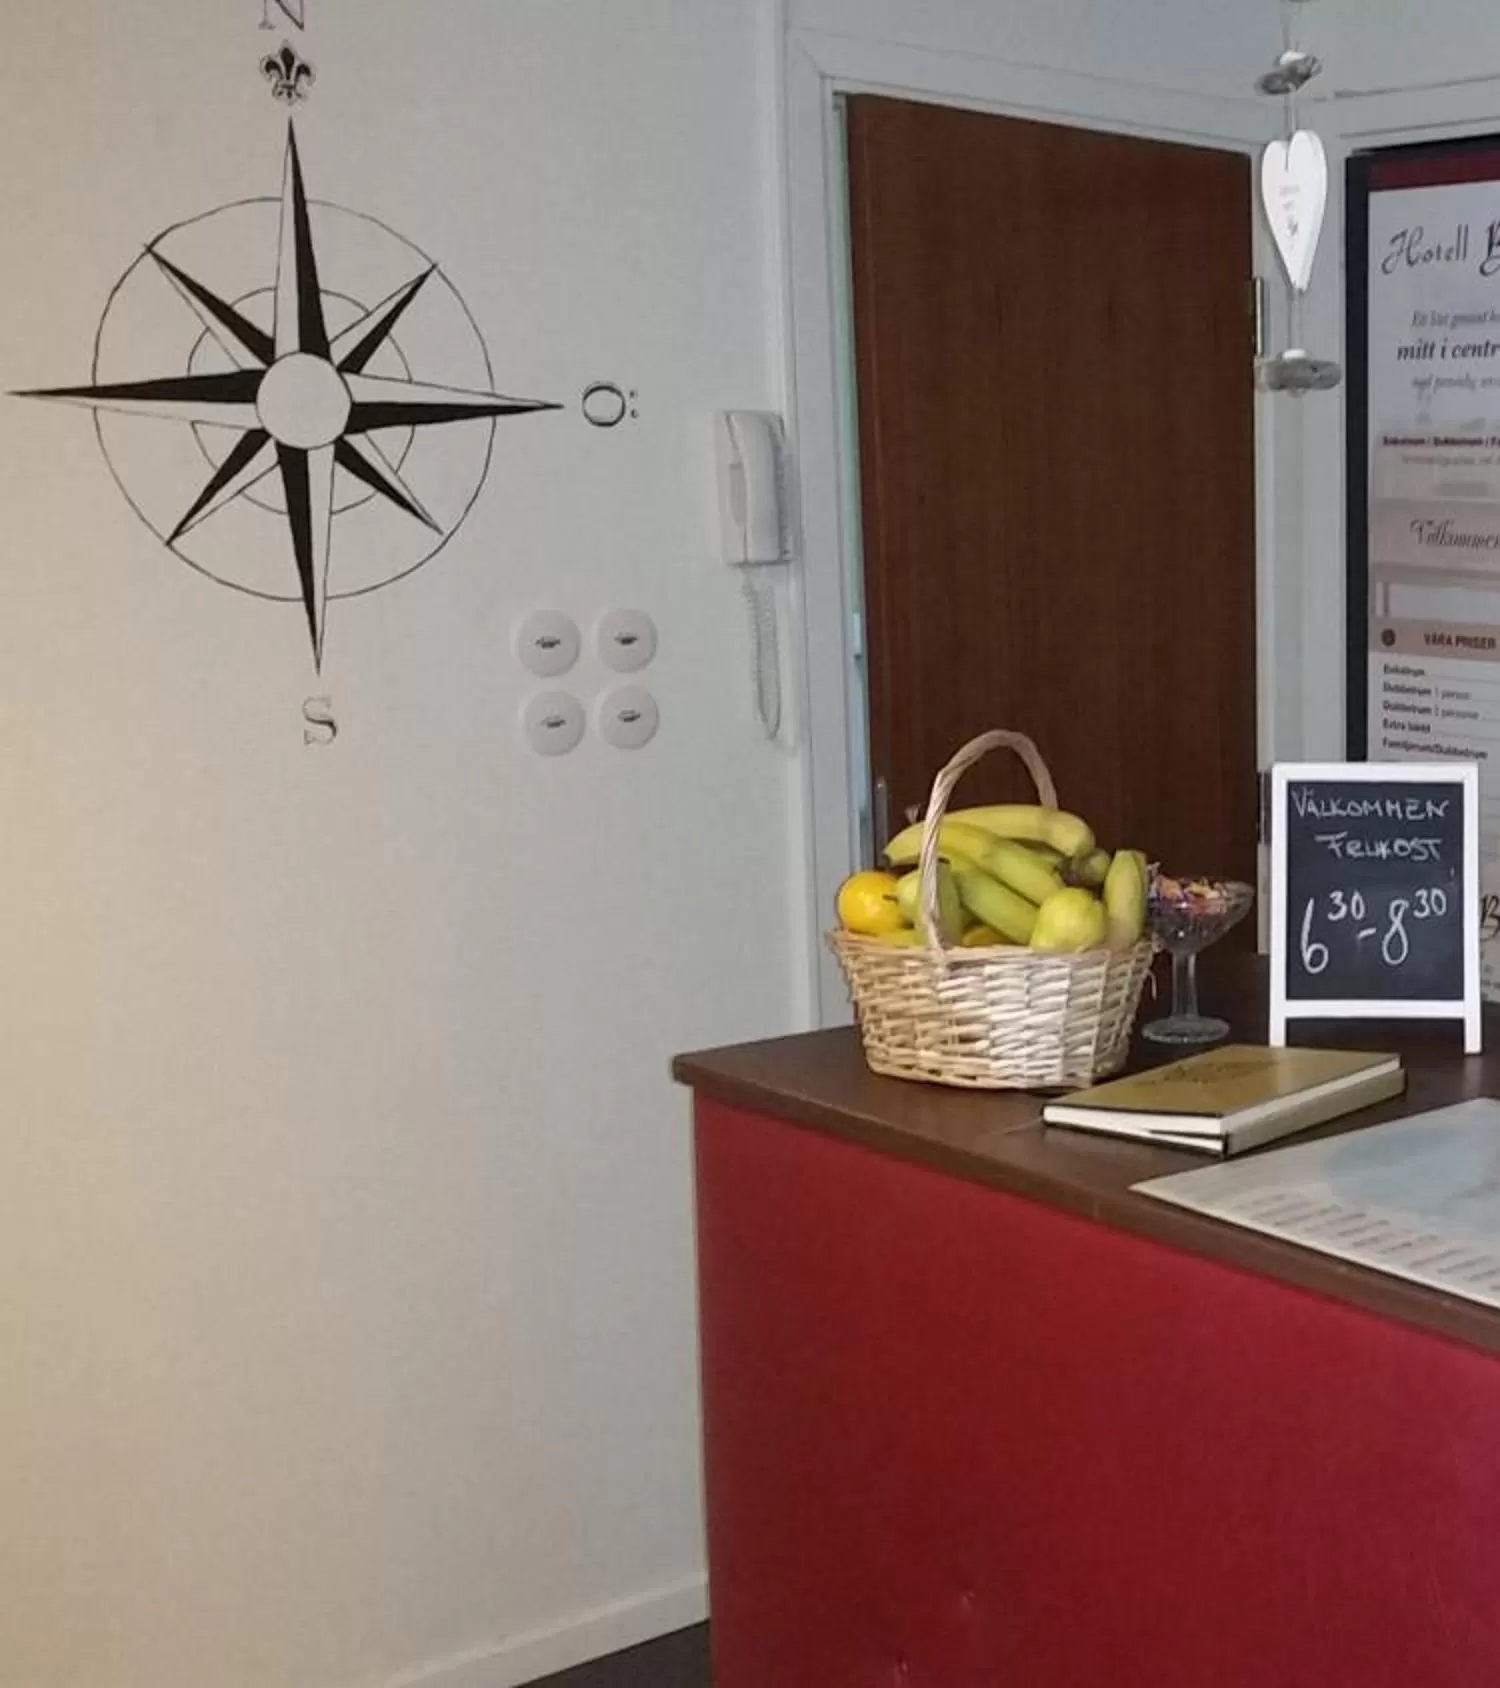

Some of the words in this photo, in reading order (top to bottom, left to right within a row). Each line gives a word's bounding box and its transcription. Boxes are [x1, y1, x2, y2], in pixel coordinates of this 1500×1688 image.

[1381, 224, 1469, 275] Hotell
[1397, 338, 1436, 361] mitt
[1440, 337, 1449, 360] i
[302, 696, 337, 746] S
[1290, 787, 1449, 821] VÄLKOMMEN
